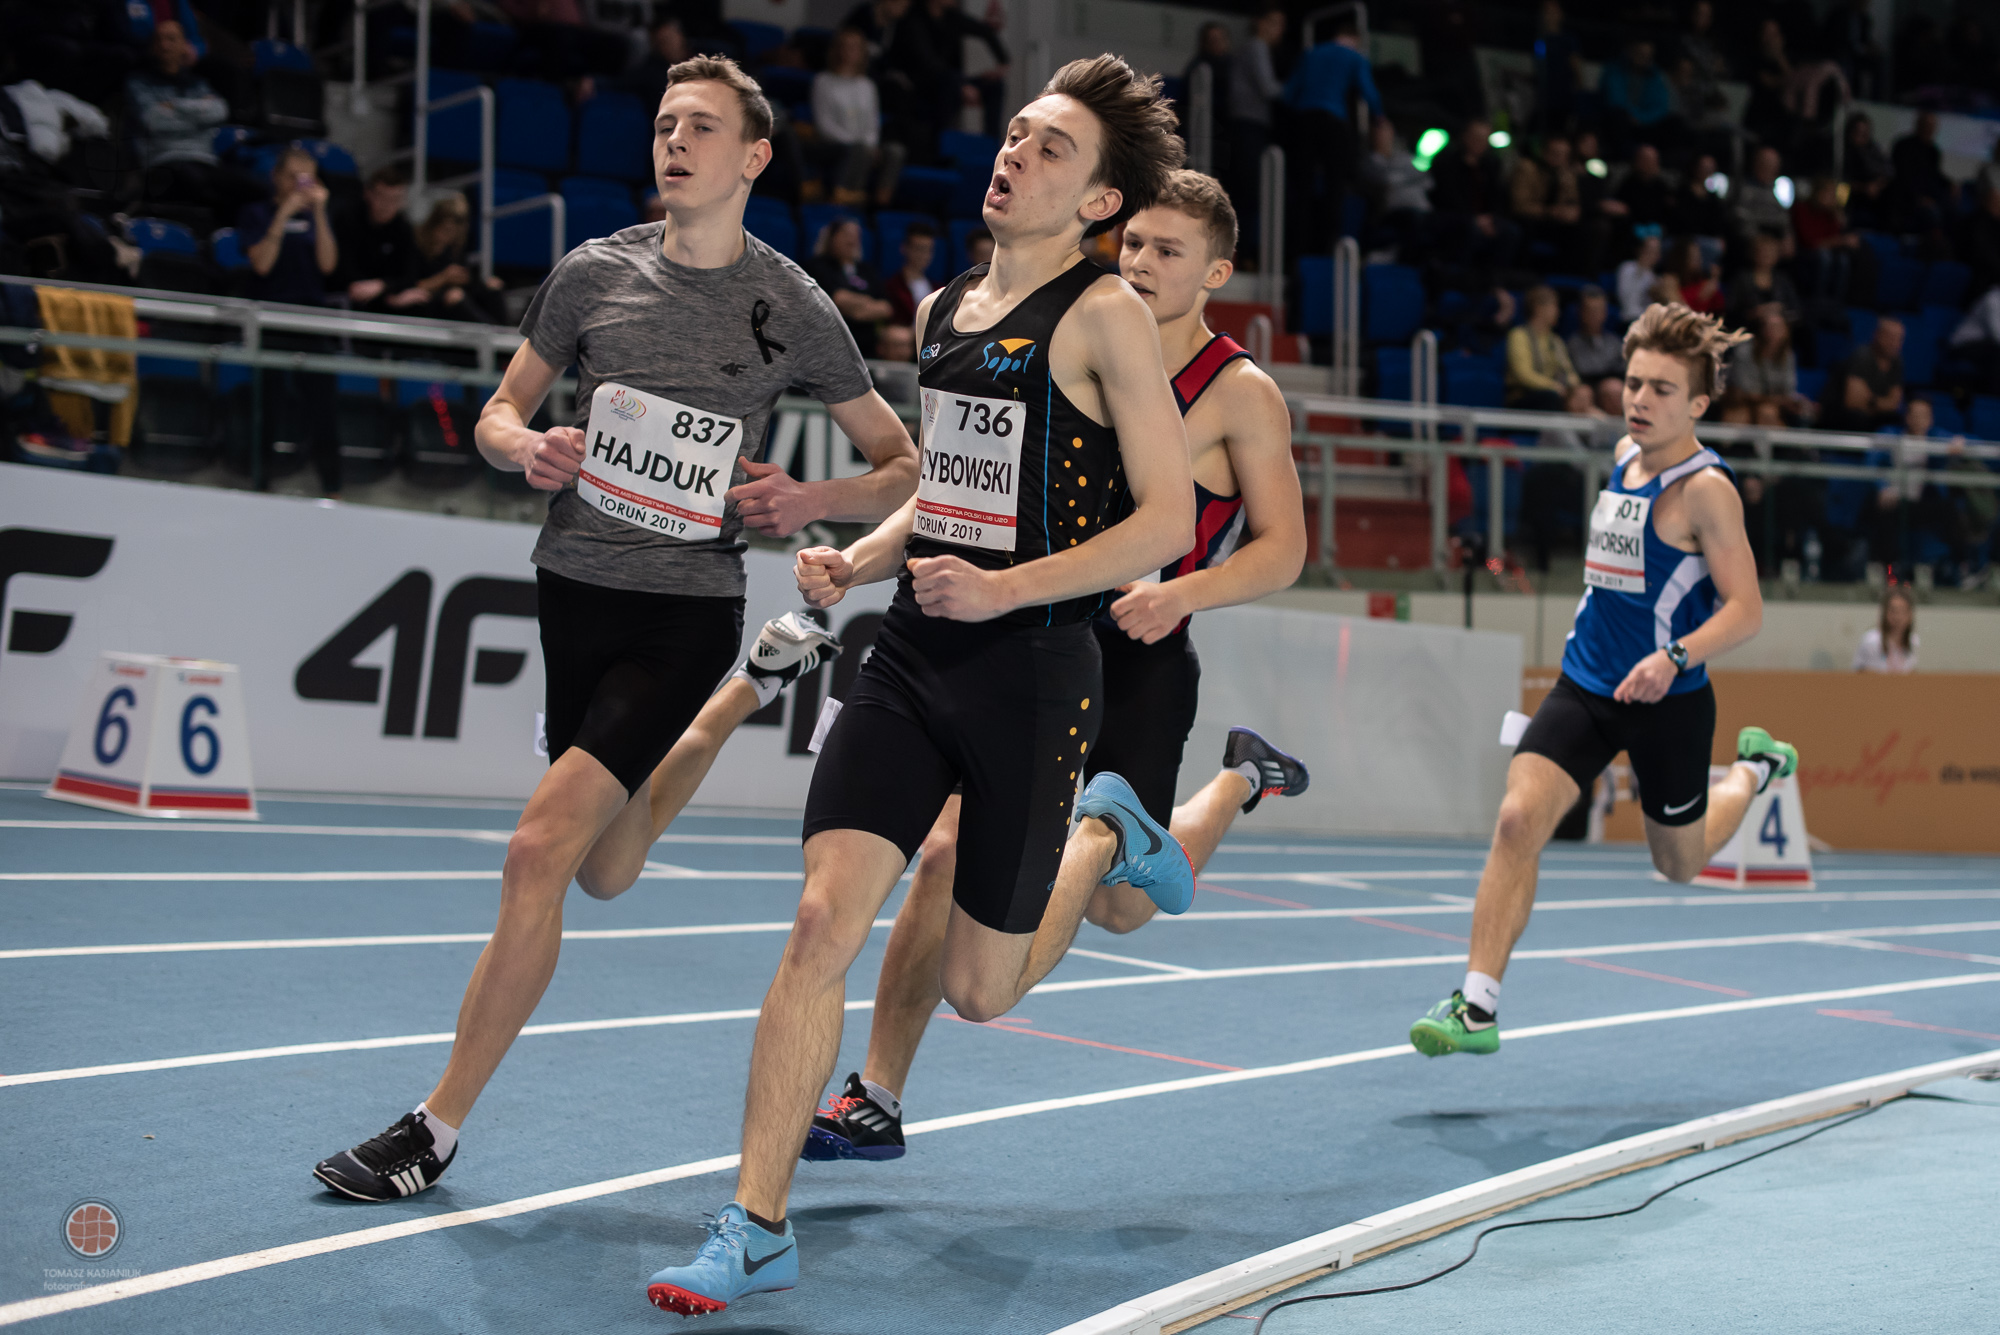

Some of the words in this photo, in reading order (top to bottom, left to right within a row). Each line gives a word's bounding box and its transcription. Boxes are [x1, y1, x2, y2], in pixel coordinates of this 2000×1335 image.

[719, 362, 748, 377] 4F
[976, 342, 1036, 381] Sopot
[671, 411, 736, 447] 837
[955, 400, 1013, 437] 736
[591, 430, 719, 497] HAJDUK
[599, 494, 647, 523] TORUŃ
[649, 514, 687, 535] 2019
[620, 490, 665, 509] MISTRZOSTWA
[665, 504, 689, 517] POLSKI
[964, 511, 982, 520] POLSKI
[917, 515, 948, 535] TORUŃ
[949, 523, 982, 542] 2019
[293, 568, 540, 740] 4F
[93, 684, 137, 766] 6
[180, 693, 220, 776] 6
[1759, 795, 1788, 857] 4
